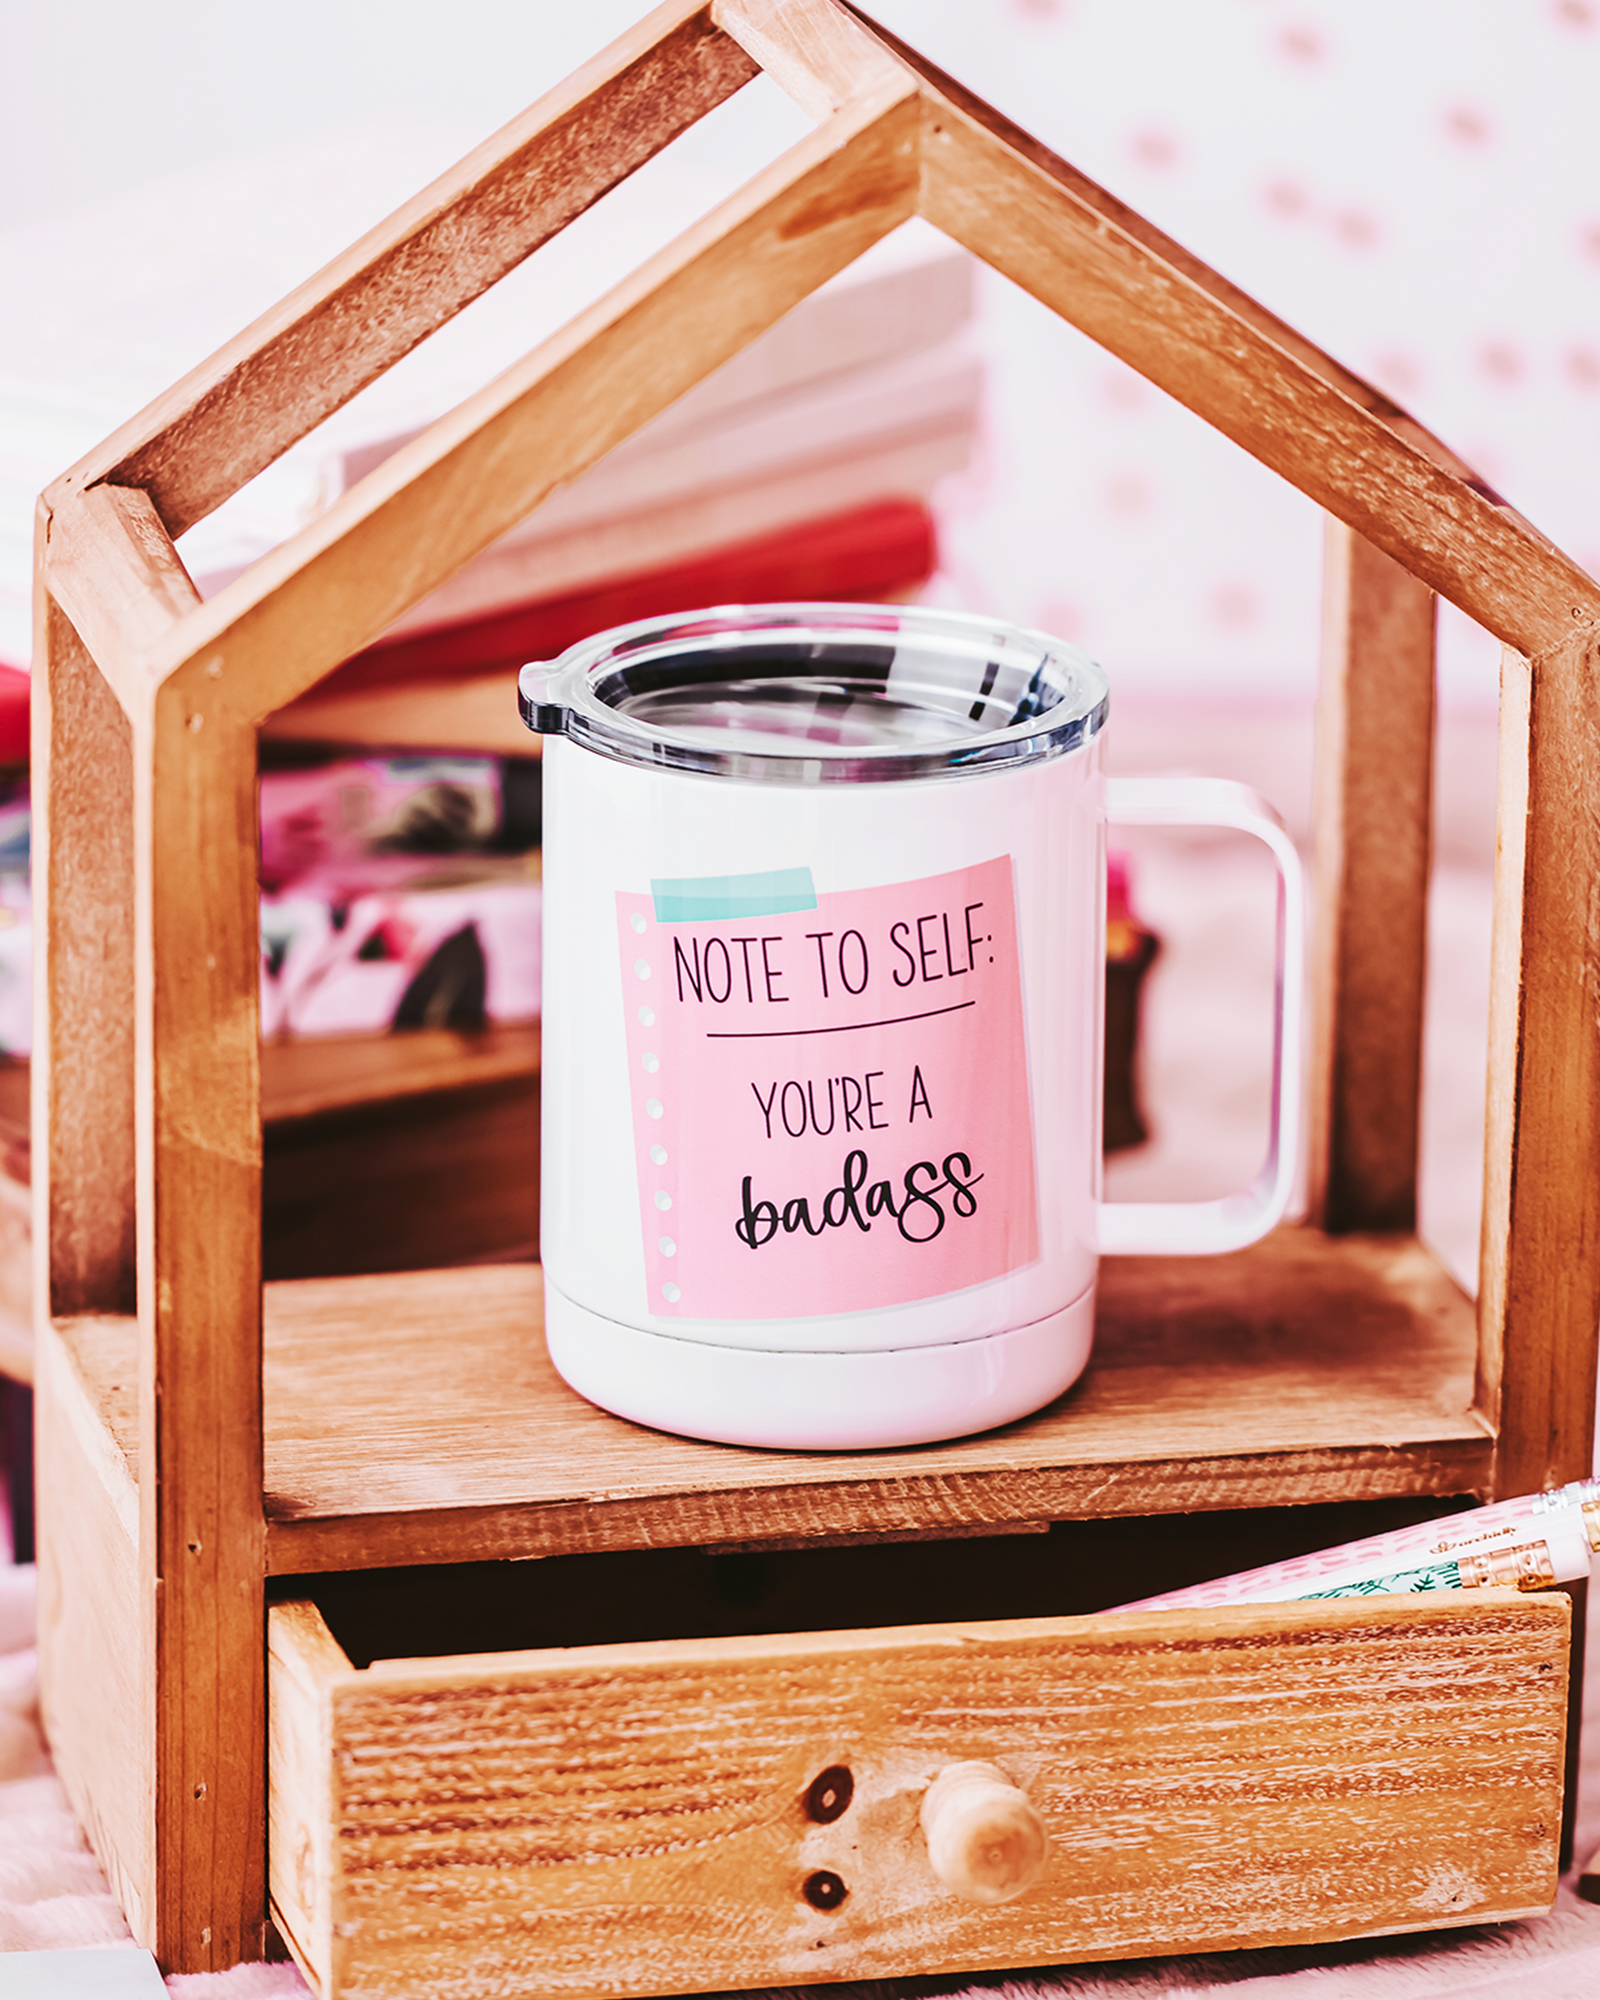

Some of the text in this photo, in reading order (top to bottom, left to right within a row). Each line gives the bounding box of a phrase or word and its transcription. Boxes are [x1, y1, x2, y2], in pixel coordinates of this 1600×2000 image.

[673, 901, 995, 1004] NOTE TO SELF:
[751, 1065, 933, 1139] YOU'RE A
[735, 1149, 985, 1250] badass
